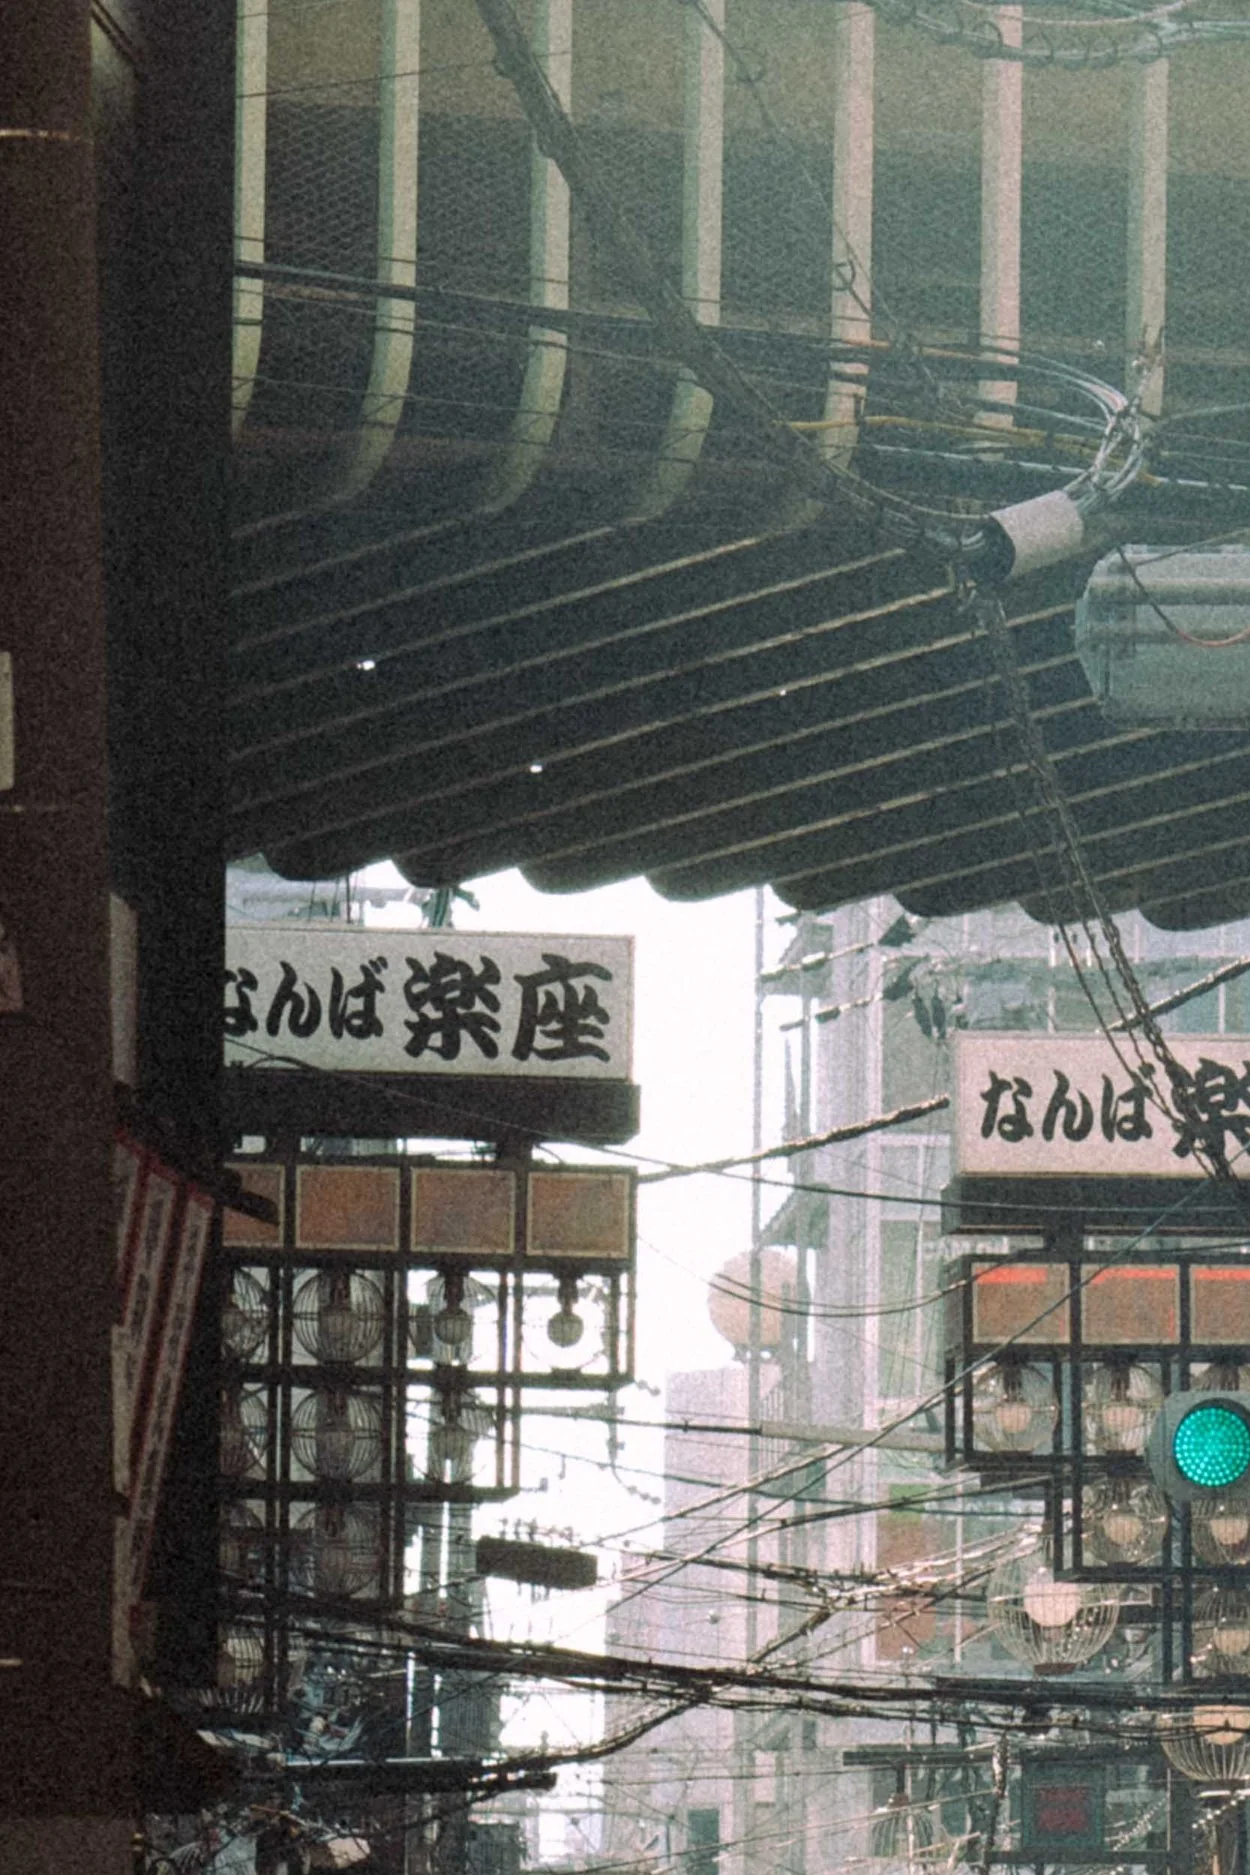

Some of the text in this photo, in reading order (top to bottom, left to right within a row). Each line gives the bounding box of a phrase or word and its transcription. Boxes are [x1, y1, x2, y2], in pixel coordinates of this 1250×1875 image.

[224, 954, 613, 1062] なんば楽座
